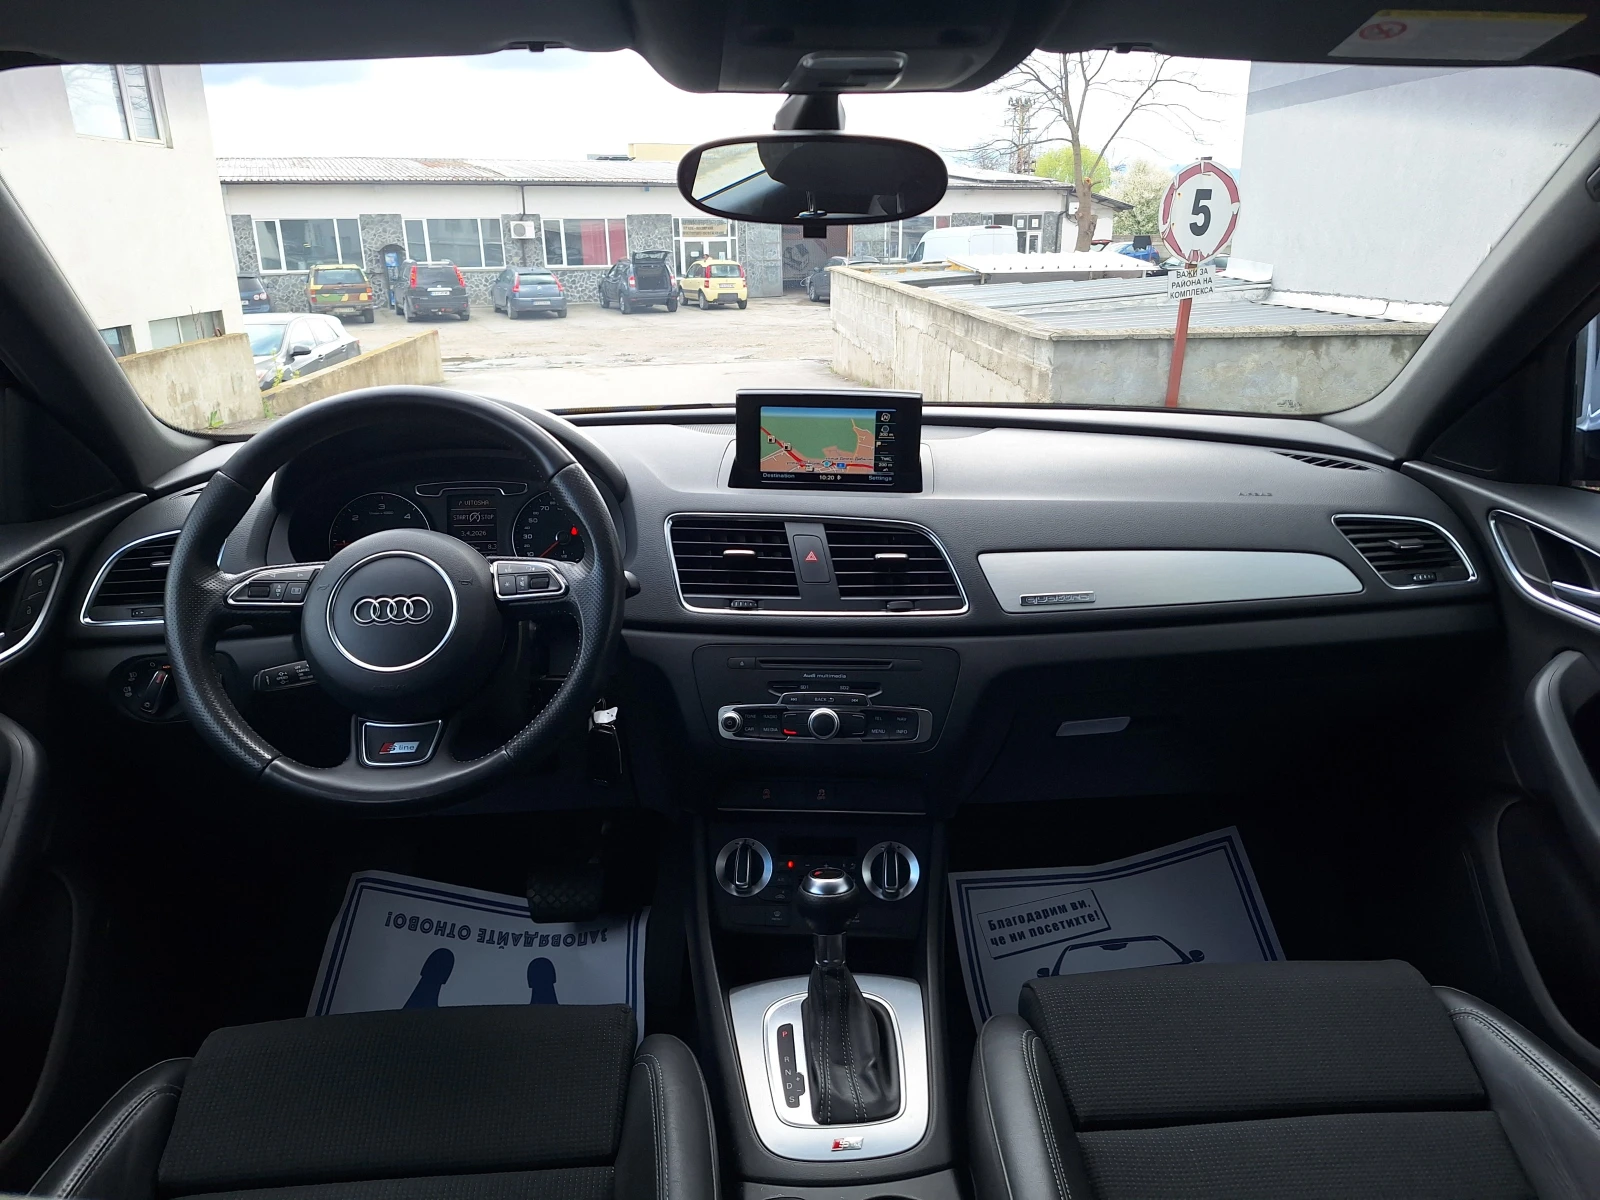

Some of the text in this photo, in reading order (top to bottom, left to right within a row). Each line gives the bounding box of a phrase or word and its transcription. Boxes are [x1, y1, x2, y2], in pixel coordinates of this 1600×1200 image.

[1189, 188, 1213, 237] 5
[1176, 267, 1209, 279] ВАЖИ ЗА
[1171, 277, 1213, 289] РАЙОНА НА
[1170, 287, 1214, 299] КОМПЛЕКСА
[988, 904, 1068, 931] Благодарим
[385, 911, 608, 950] ЗАПОВЯДАЙТЕ ОТНОВО!
[990, 911, 1100, 947] че ни посетихте!
[782, 1030, 788, 1038] P
